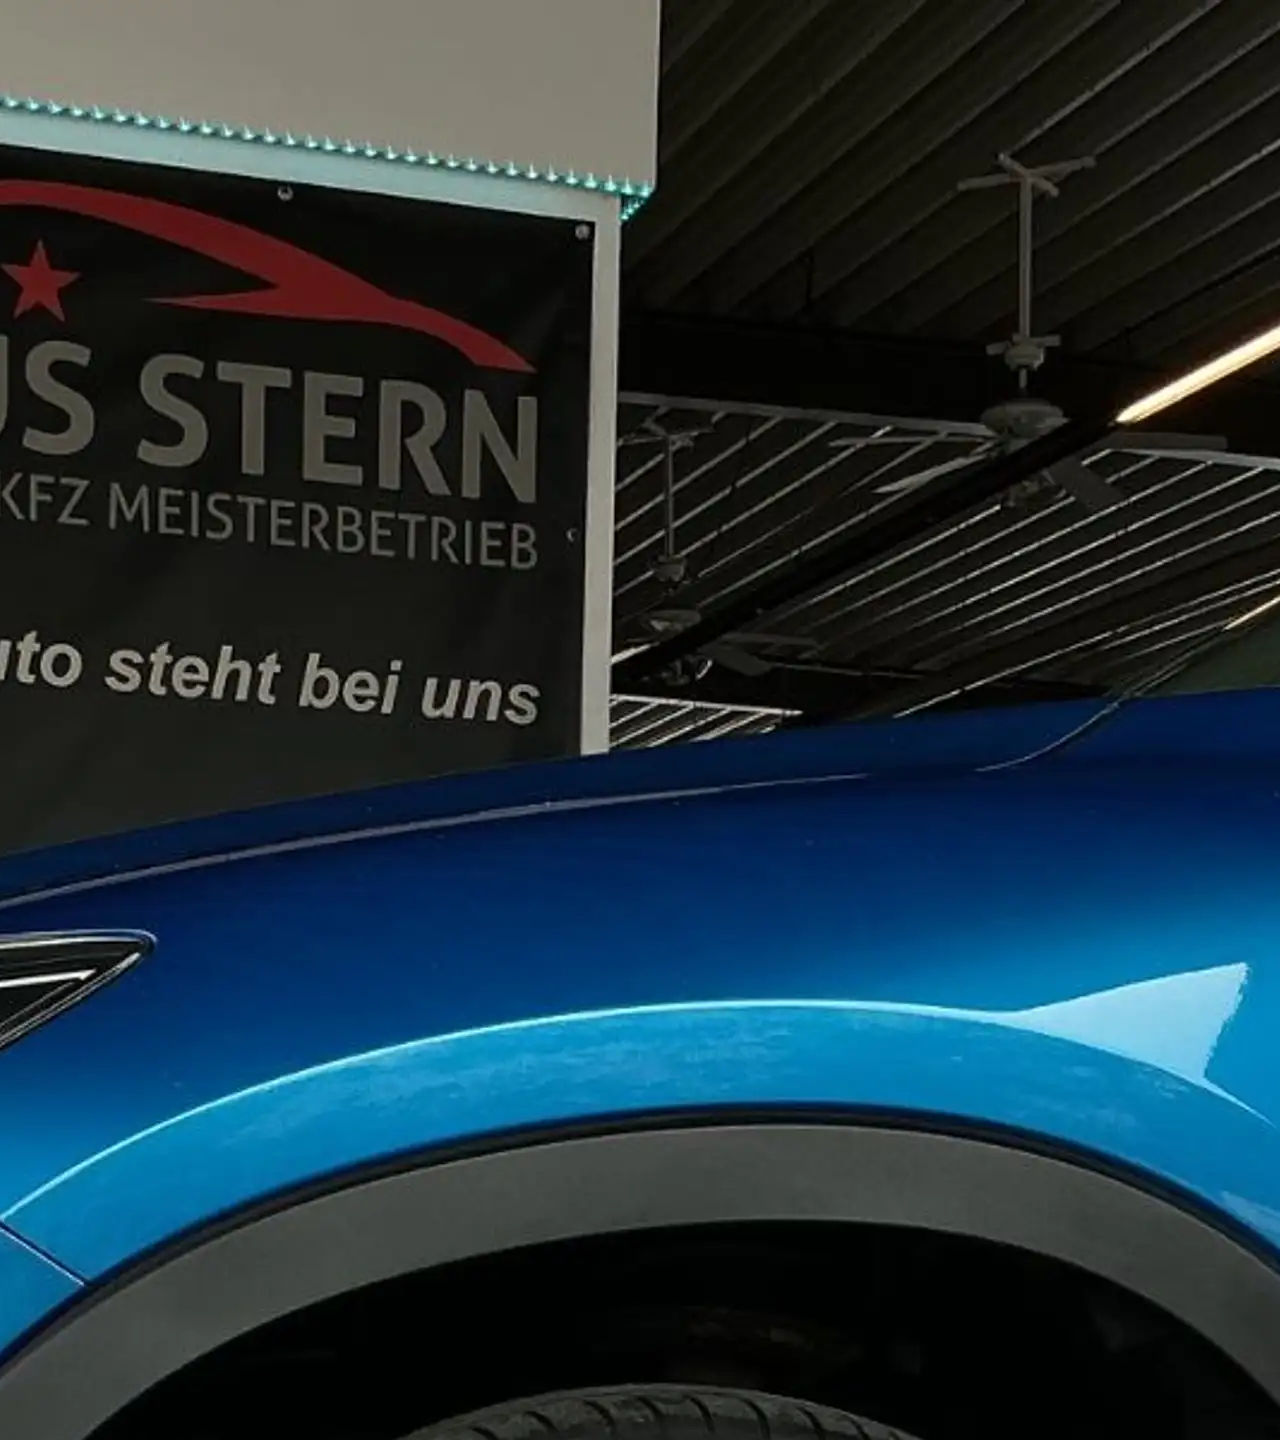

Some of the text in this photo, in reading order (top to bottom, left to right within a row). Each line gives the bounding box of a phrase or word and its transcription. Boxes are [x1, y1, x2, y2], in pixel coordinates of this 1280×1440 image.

[136, 353, 538, 503] STERN
[108, 481, 539, 571] MEISTERBETRIEB
[104, 641, 282, 705] steht
[298, 652, 404, 715] bei
[420, 673, 542, 726] uns
